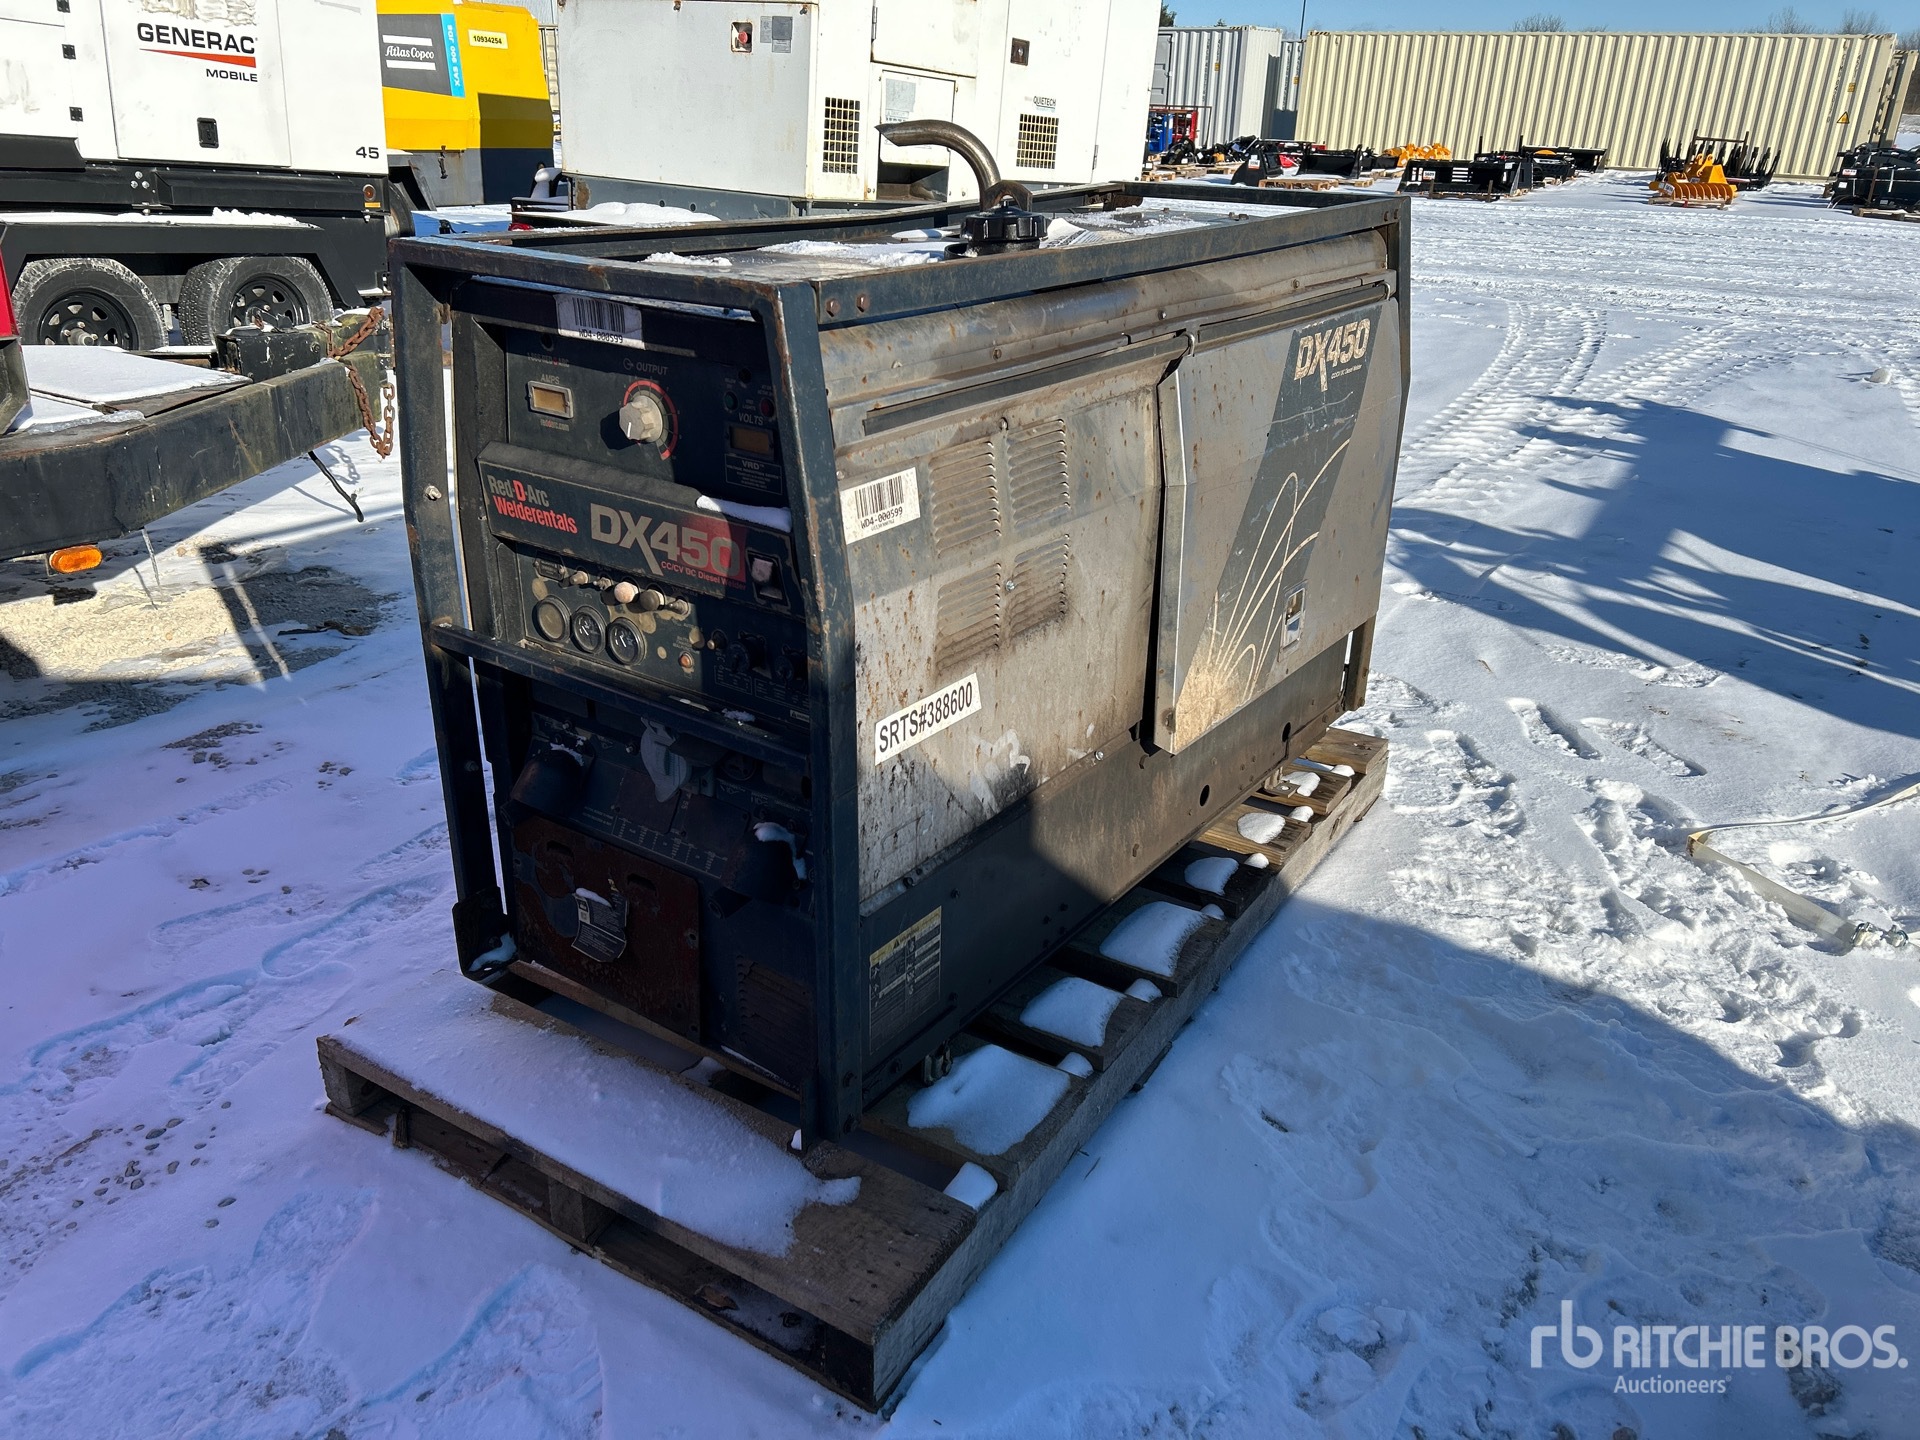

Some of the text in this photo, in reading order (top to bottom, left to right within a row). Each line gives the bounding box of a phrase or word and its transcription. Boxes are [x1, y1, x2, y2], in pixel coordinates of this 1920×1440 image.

[137, 22, 256, 54] GENERAC
[473, 35, 503, 45] 10934254
[385, 45, 435, 60] Atlas Copco
[206, 68, 258, 82] MOBILE
[355, 146, 379, 159] 45
[1294, 318, 1371, 393] DX450
[636, 361, 669, 376] OUTPUT
[540, 373, 560, 385] AMPS
[738, 411, 764, 426] VOLTS
[492, 495, 578, 534] Welderentals
[860, 506, 904, 529] WD4-000599
[590, 502, 741, 577] DX450
[661, 560, 747, 590] CC/CV DC Diesel Welder
[879, 681, 973, 753] SRTS#388600
